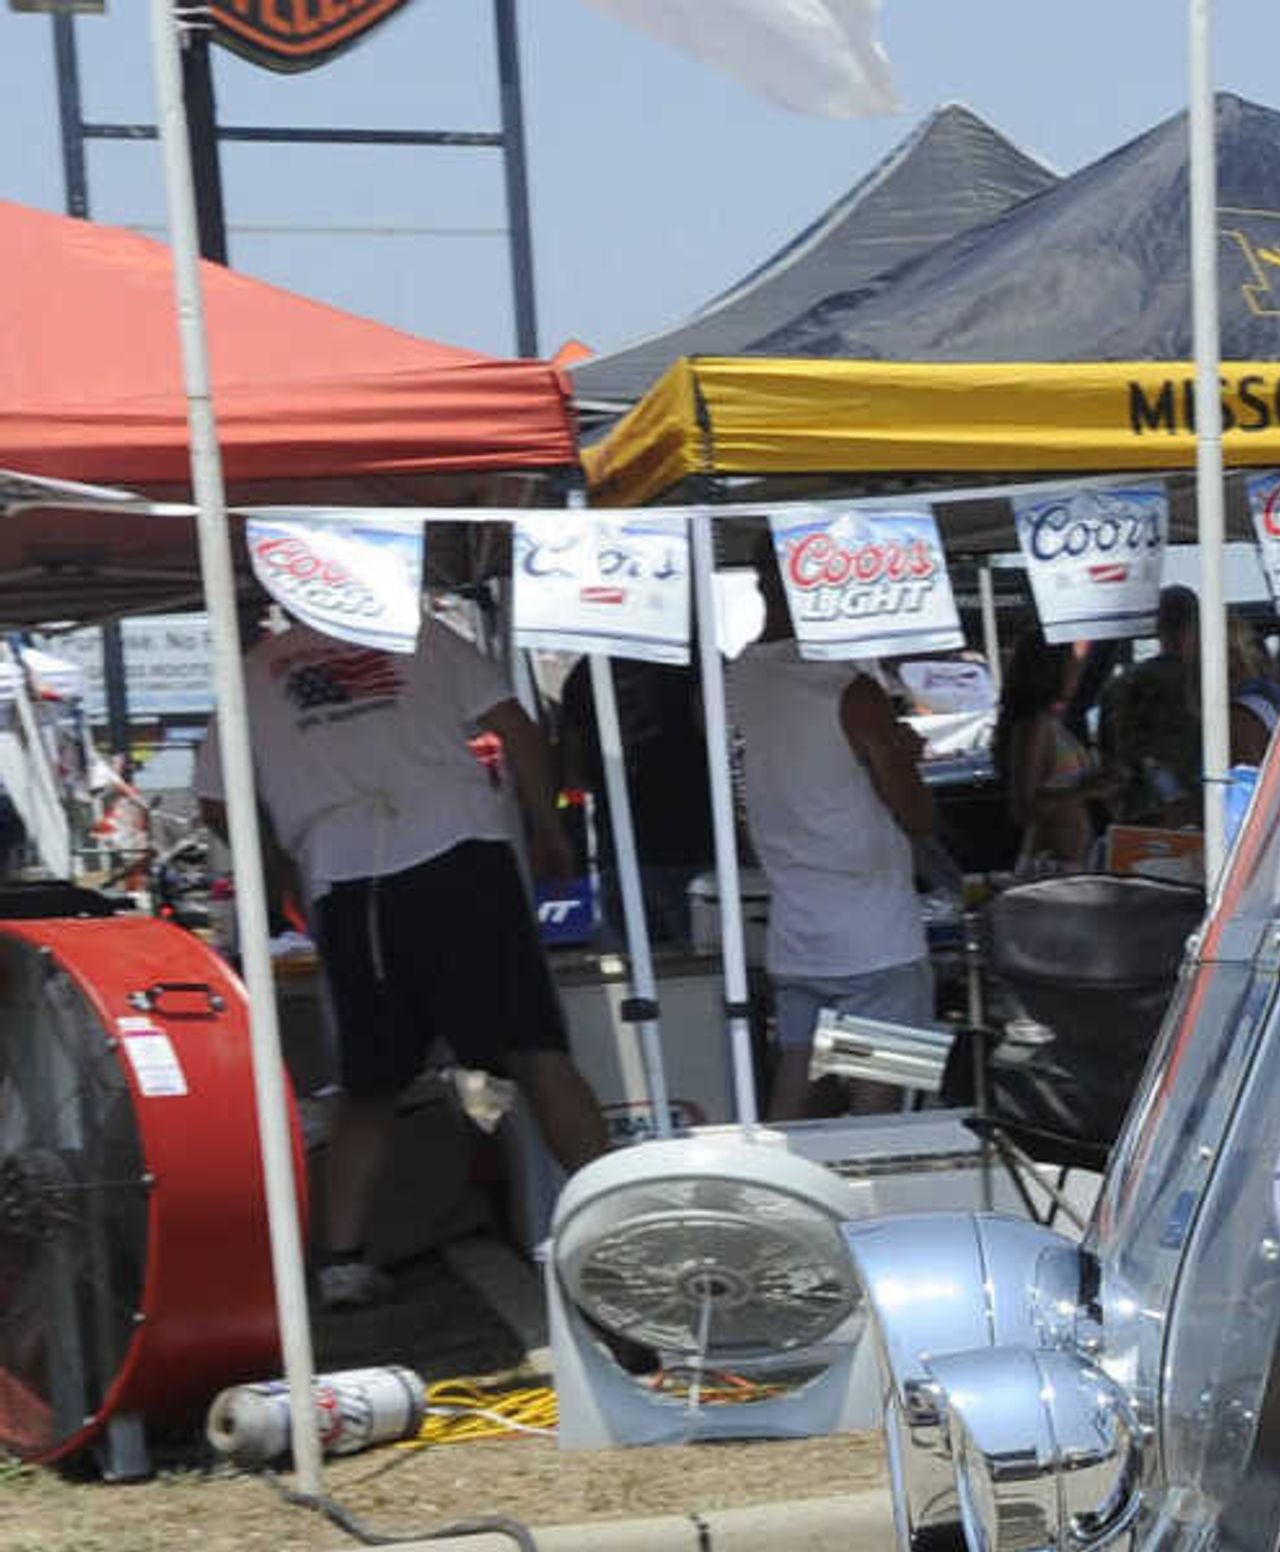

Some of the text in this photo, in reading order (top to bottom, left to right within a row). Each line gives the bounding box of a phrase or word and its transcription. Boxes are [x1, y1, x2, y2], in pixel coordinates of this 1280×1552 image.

[522, 534, 676, 580] Cos
[1025, 505, 1161, 562] Coors
[785, 532, 937, 590] Coors
[800, 578, 934, 622] LIGHT
